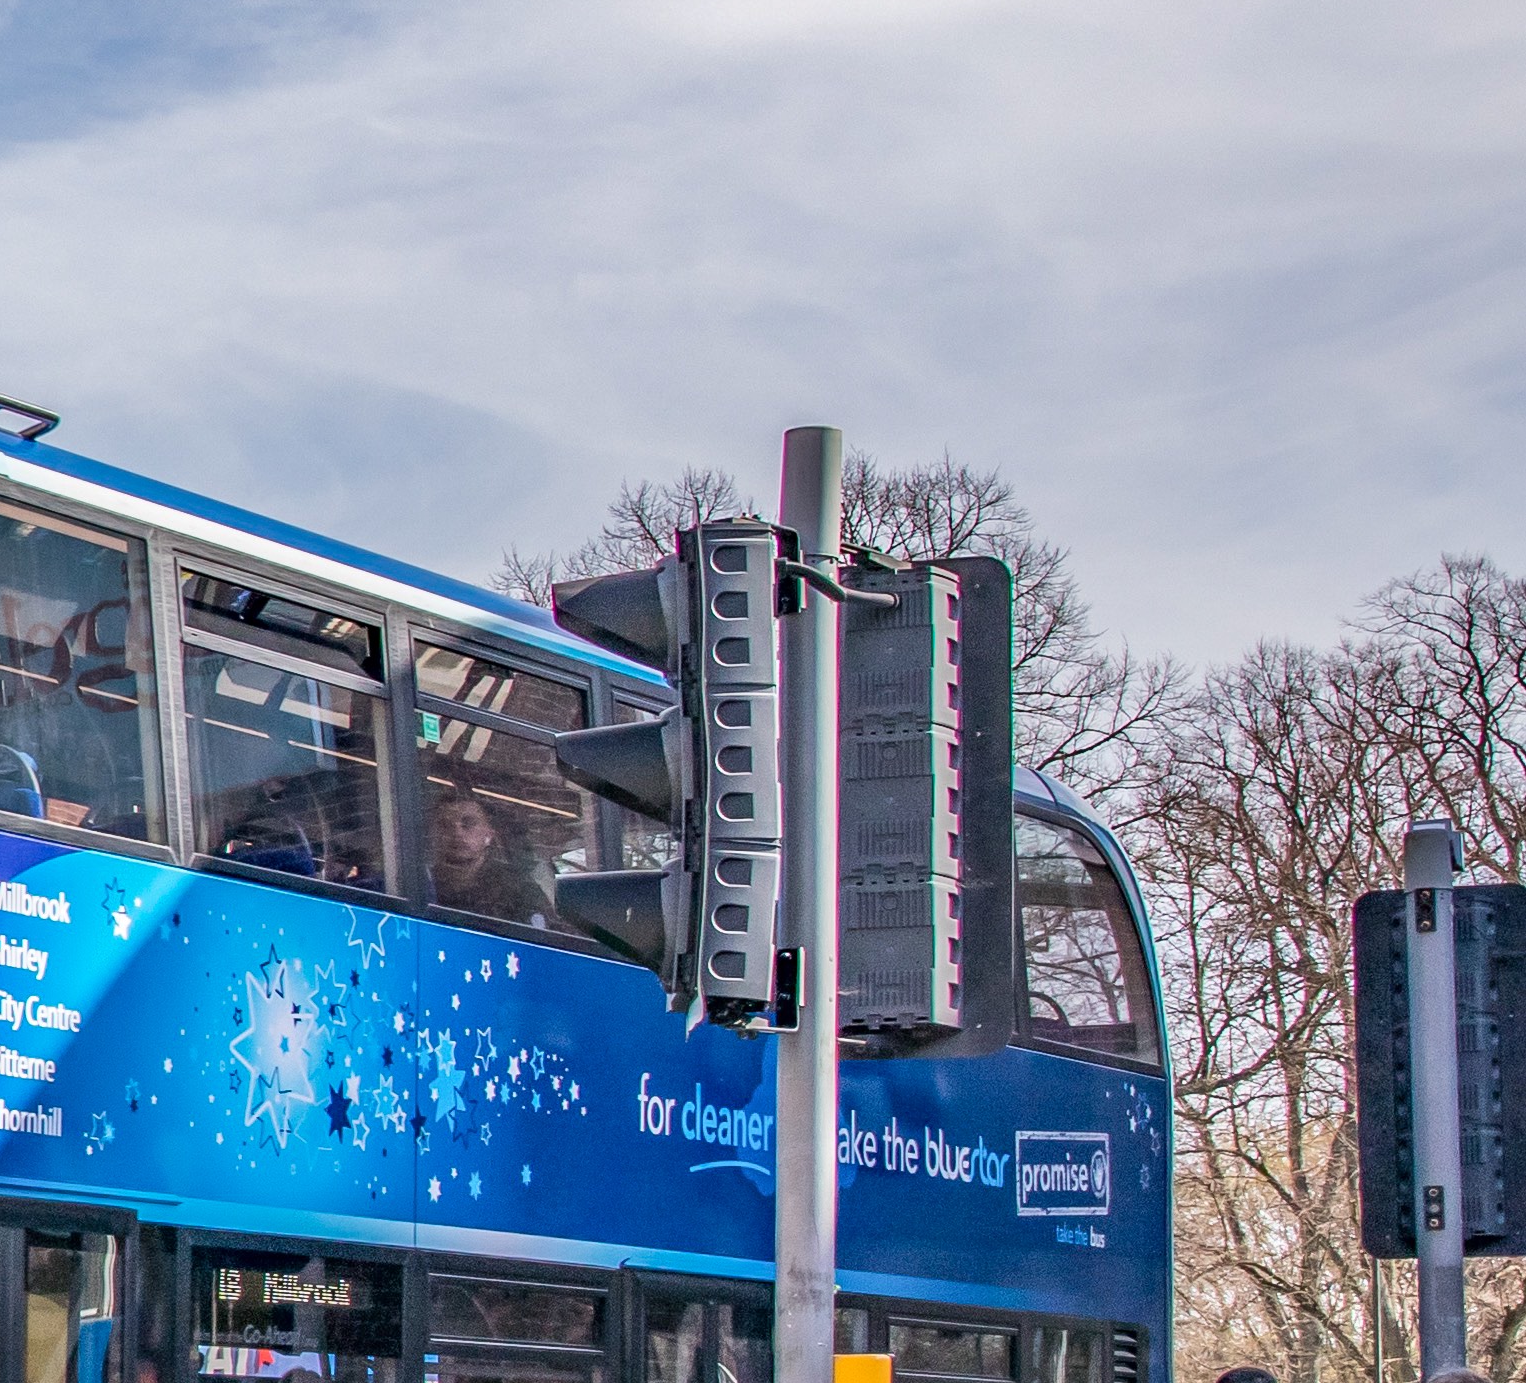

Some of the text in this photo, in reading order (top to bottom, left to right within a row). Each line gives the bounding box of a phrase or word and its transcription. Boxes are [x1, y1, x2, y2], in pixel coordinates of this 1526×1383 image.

[25, 995, 81, 1032] Centre
[638, 1073, 676, 1136] for
[681, 1083, 774, 1151] cleaner
[883, 1117, 919, 1174] the
[925, 1126, 1010, 1188] bluestar
[1021, 1154, 1089, 1193] promise
[1056, 1225, 1106, 1248] take the bus
